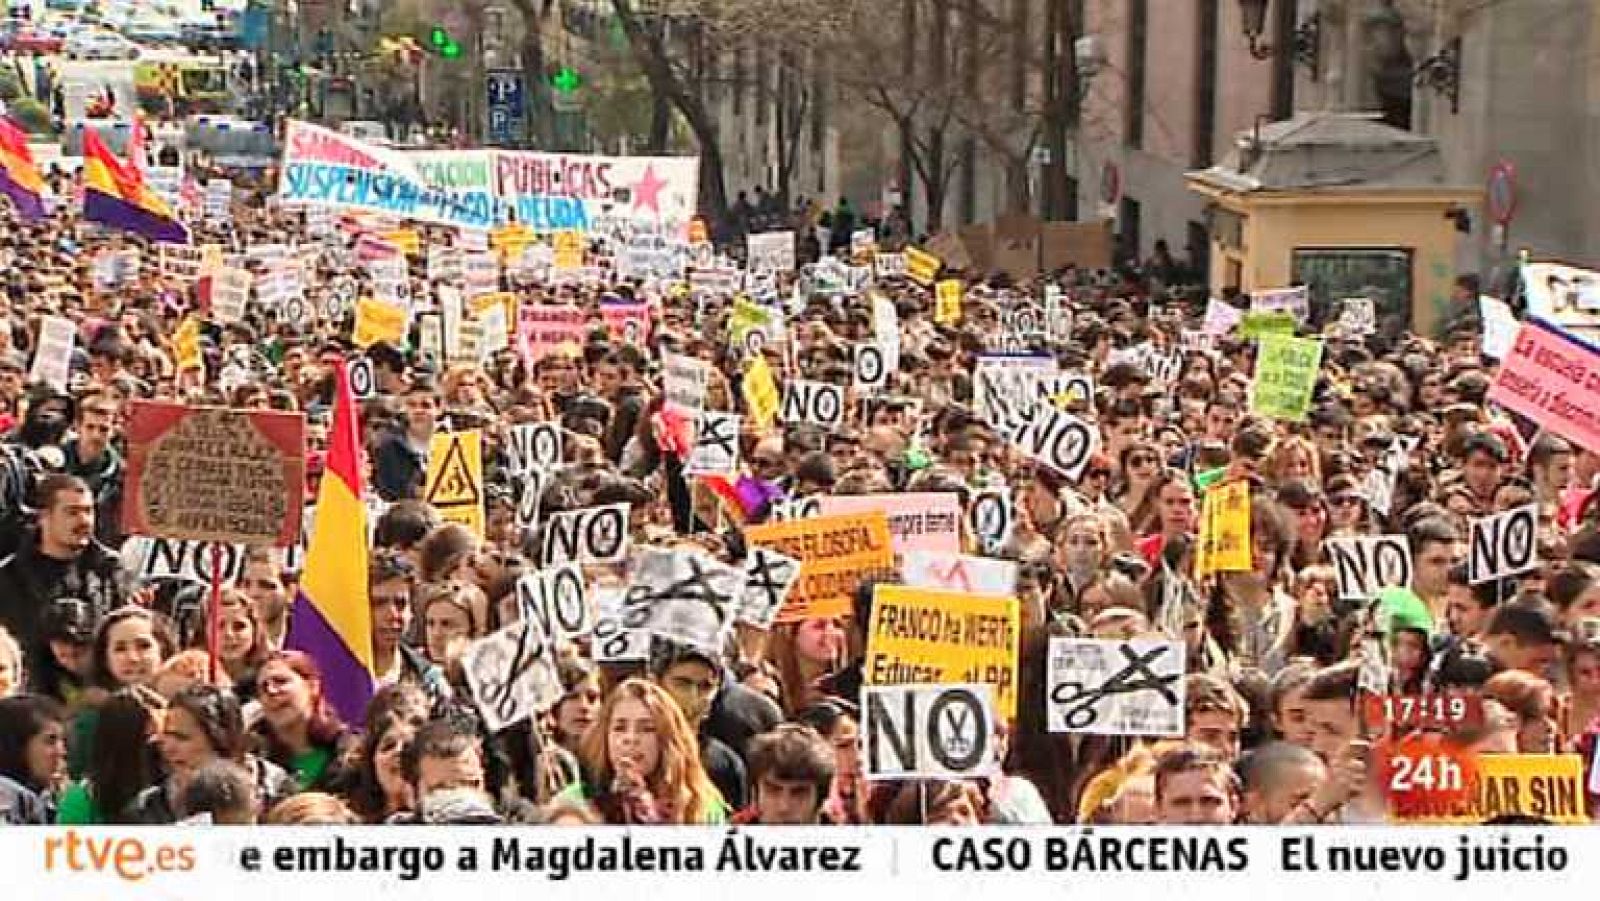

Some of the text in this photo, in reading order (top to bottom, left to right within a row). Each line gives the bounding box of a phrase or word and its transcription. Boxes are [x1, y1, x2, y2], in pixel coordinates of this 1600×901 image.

[784, 386, 841, 422] NO
[508, 425, 559, 469] NO
[1014, 411, 1090, 470] NO
[148, 537, 236, 582] NO
[546, 507, 623, 560] NO
[1472, 509, 1535, 579] NO
[1334, 539, 1410, 594] NO
[520, 566, 585, 637] NO
[878, 603, 942, 642] FRANCO
[867, 689, 988, 774] NO
[1528, 774, 1577, 819] SIN
